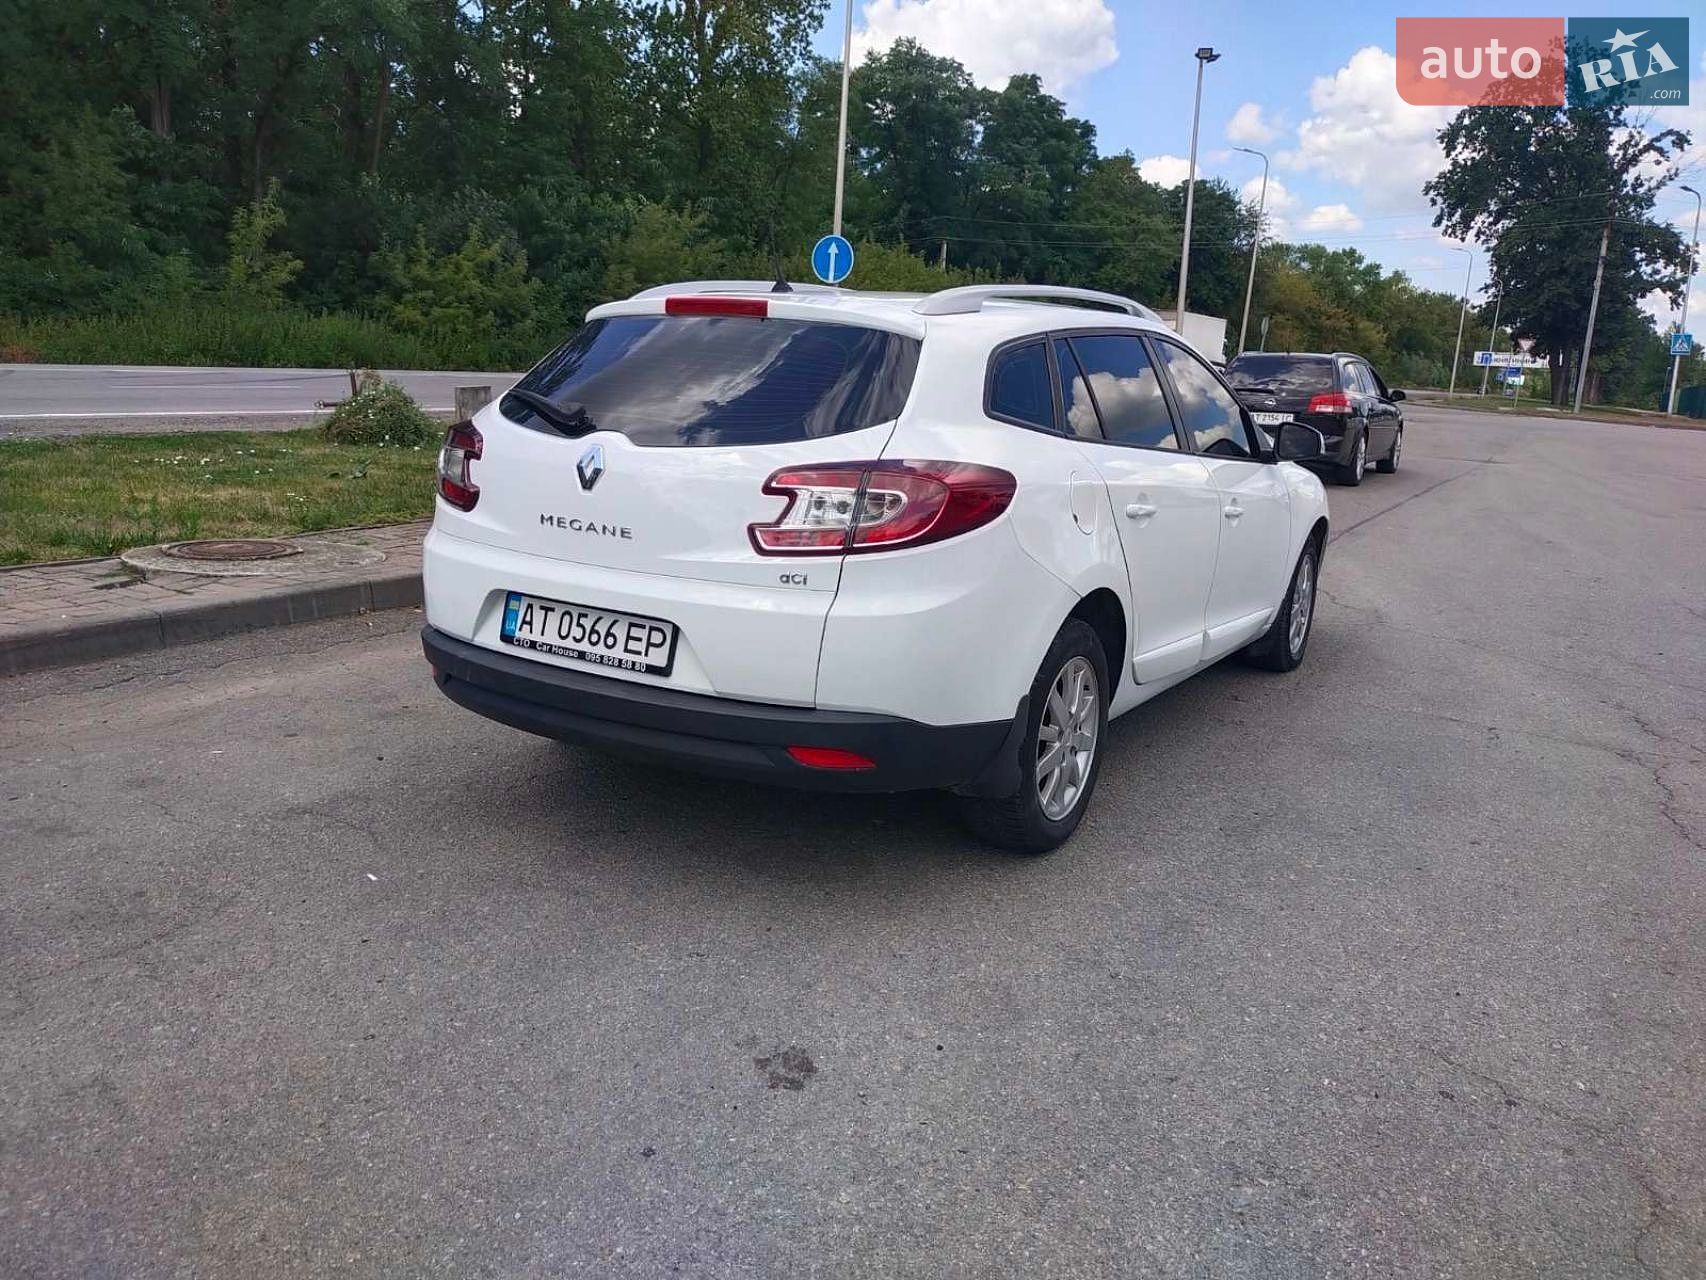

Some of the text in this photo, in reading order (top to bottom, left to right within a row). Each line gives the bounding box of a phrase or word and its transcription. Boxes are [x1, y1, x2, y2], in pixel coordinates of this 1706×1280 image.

[540, 513, 633, 540] MEGANE
[518, 602, 667, 658] AT 0566 EP
[536, 641, 550, 653] Car
[552, 645, 579, 658] House
[585, 652, 601, 663] 095
